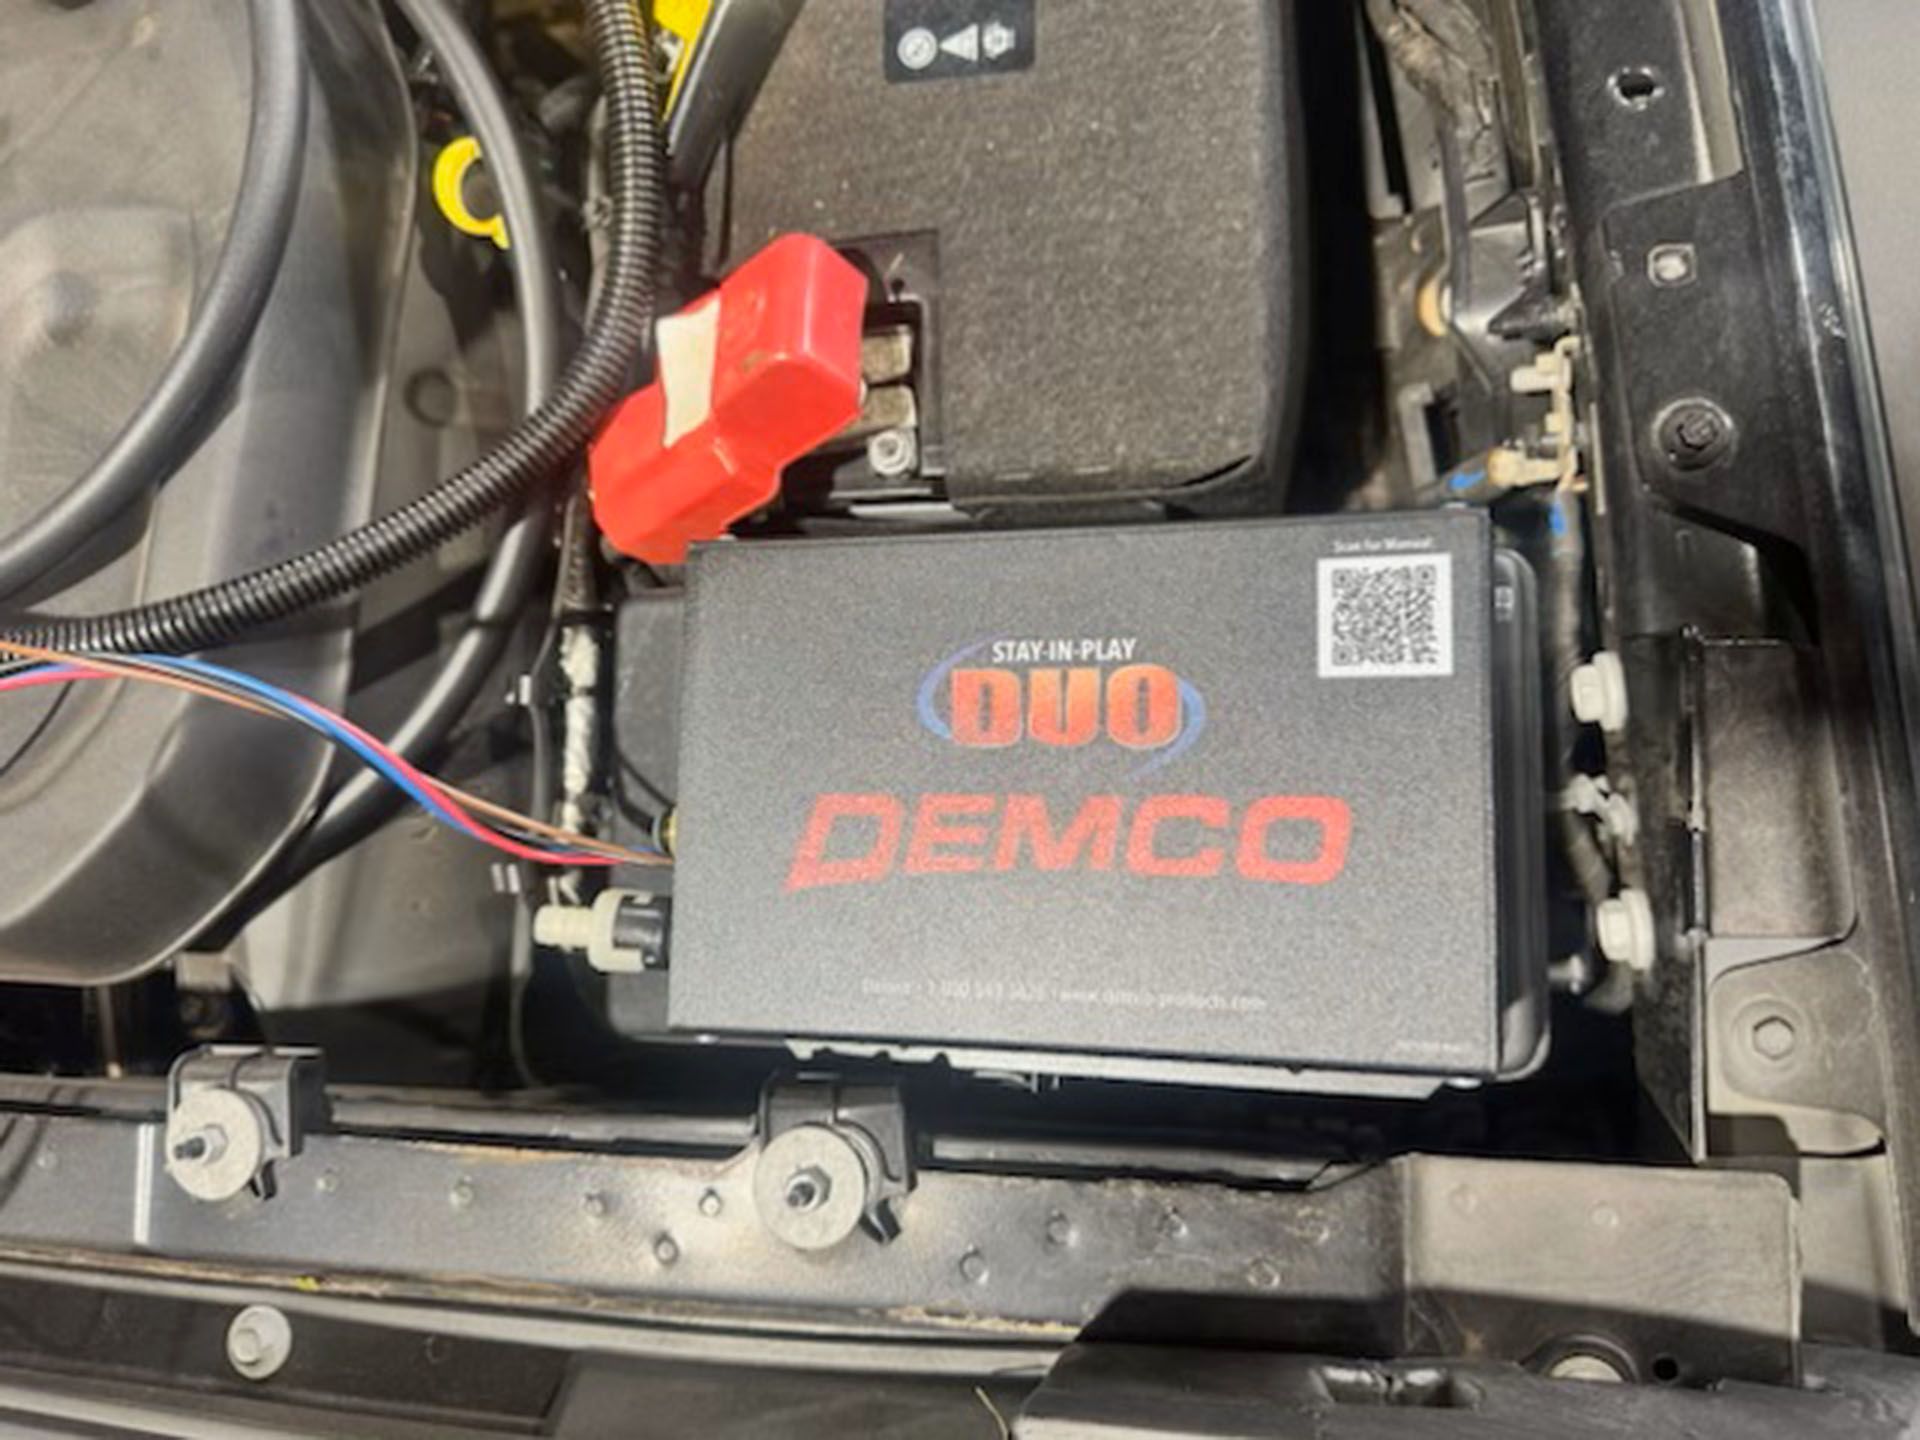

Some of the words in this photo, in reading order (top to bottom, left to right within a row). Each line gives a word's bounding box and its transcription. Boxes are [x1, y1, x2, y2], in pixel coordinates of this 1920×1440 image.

[991, 637, 1137, 663] STAY-IN-PLAY
[951, 663, 1181, 749] DUO
[785, 792, 1353, 892] DEMCO
